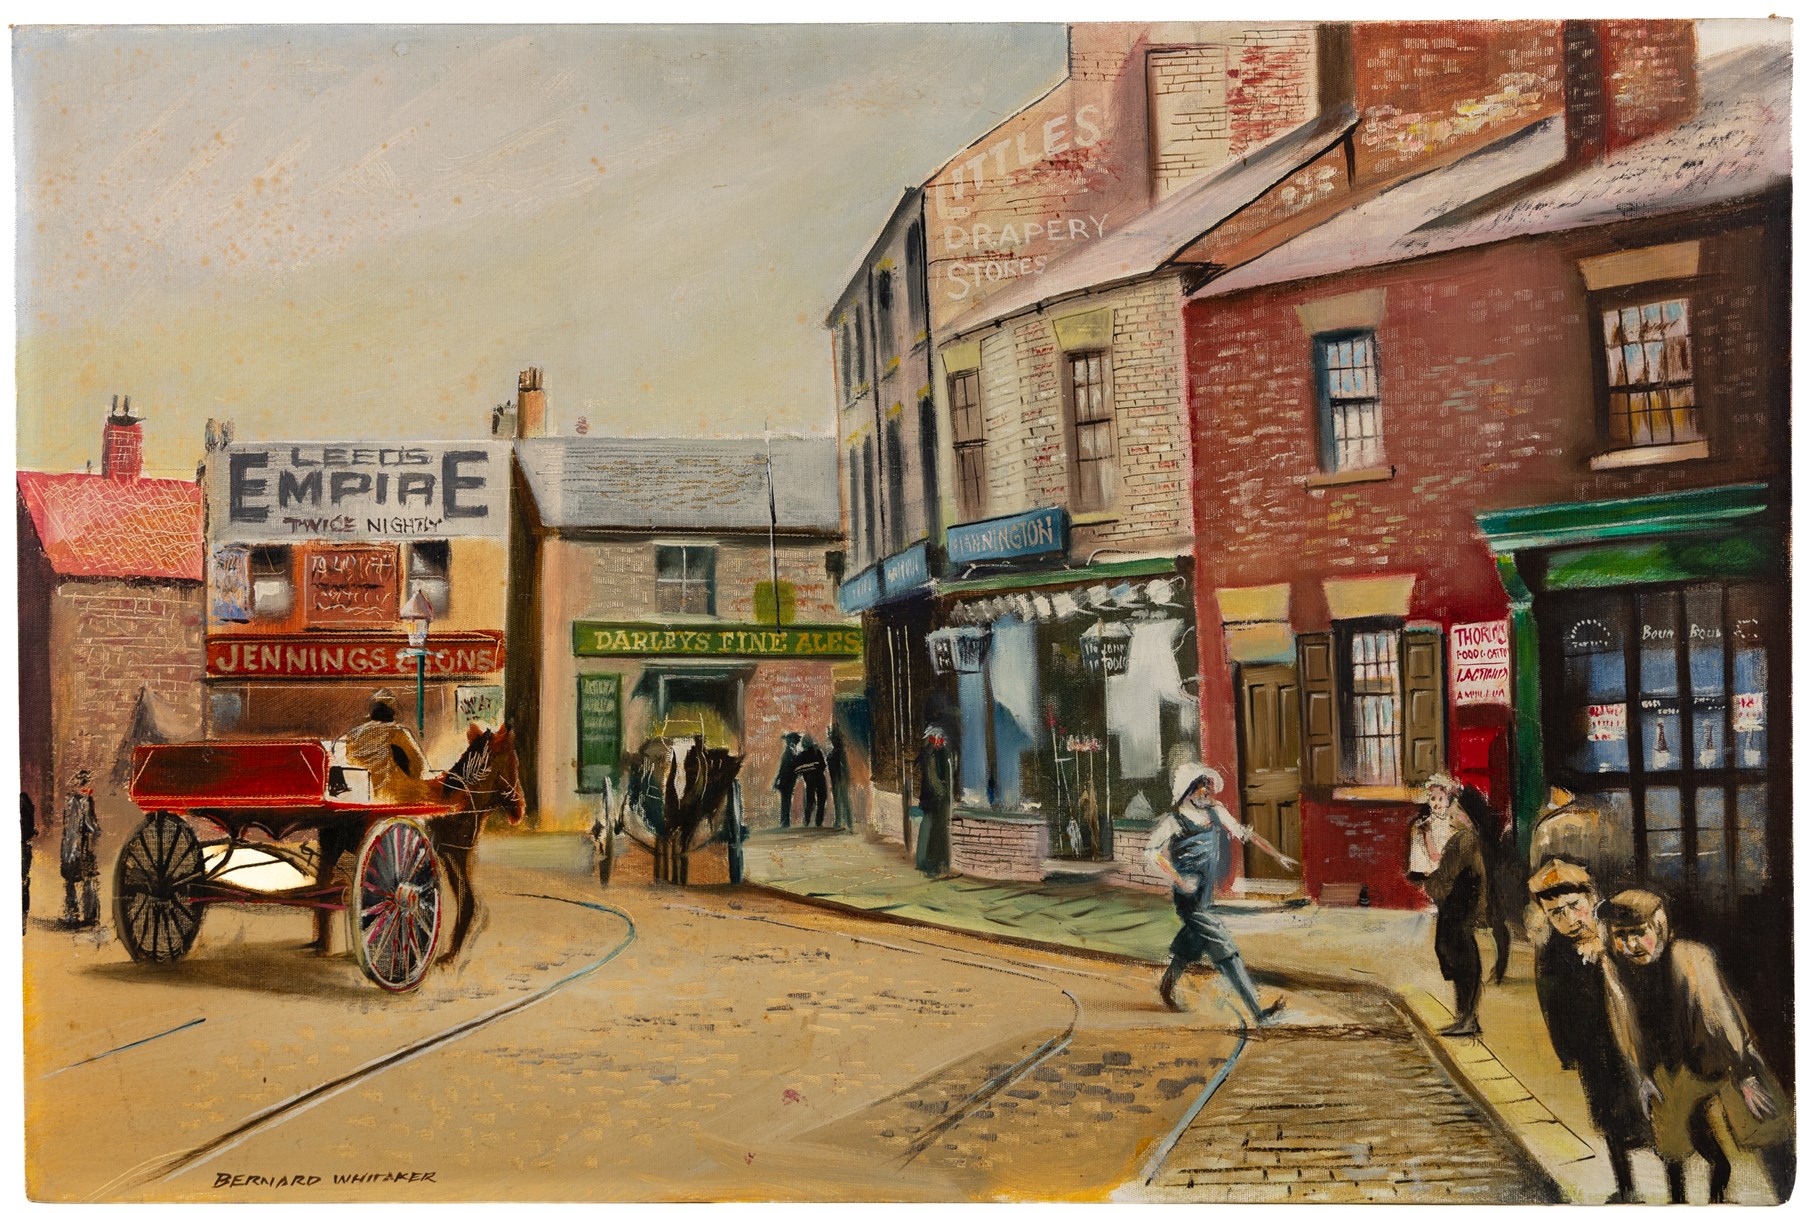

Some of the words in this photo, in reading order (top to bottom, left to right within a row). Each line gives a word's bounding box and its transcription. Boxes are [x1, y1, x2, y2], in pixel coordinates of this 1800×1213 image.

[935, 104, 1101, 219] LITTLES
[943, 213, 1109, 251] DRAPERY
[946, 255, 1048, 299] STORES
[290, 446, 433, 467] LEEDS
[229, 450, 489, 522] EMPIRE
[282, 515, 356, 533] TWICE
[367, 515, 443, 533] NIGHTLY
[593, 630, 712, 651] DARLEYS
[717, 630, 788, 652] FINE
[795, 631, 862, 654] ALES
[215, 643, 386, 673] JENNINGS
[212, 1172, 322, 1188] BERNARD
[333, 1171, 437, 1184] WHITAKER
